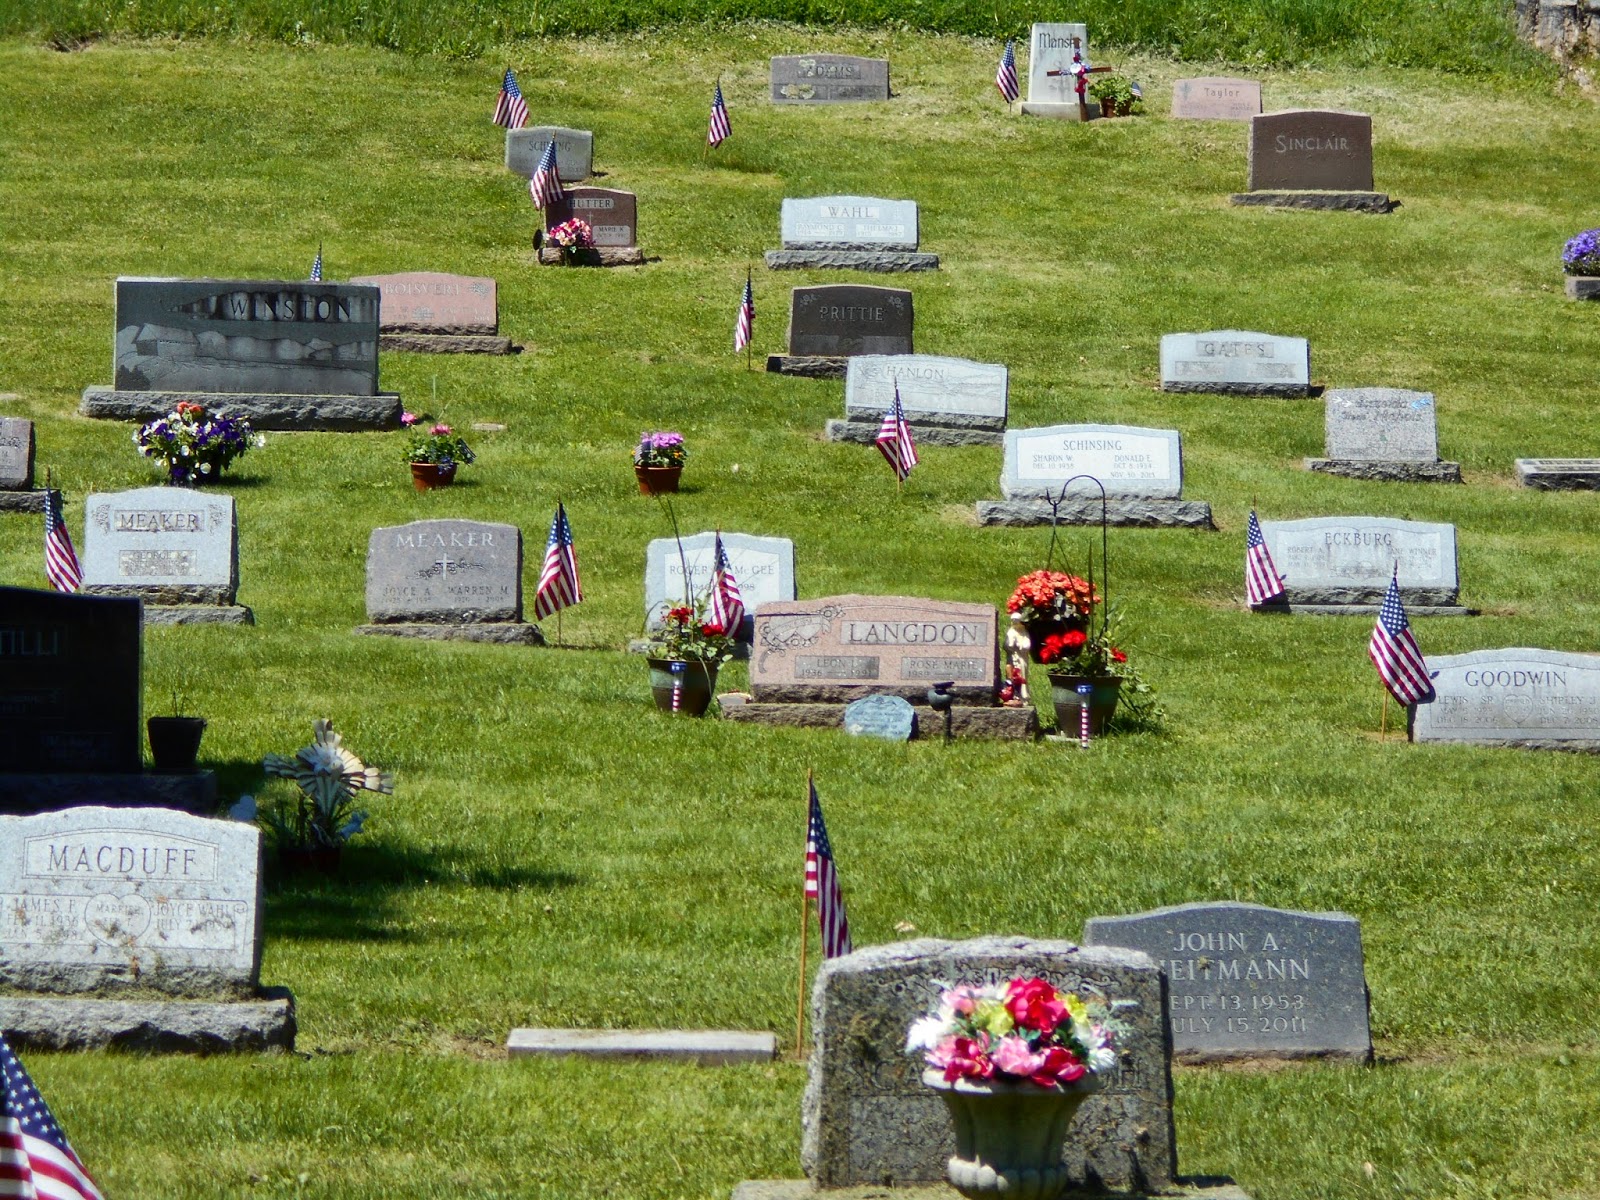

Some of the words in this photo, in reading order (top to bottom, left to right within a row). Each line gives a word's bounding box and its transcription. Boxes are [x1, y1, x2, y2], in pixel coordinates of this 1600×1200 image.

[1203, 87, 1240, 98] Taylor
[569, 200, 611, 208] HUTTER
[828, 206, 874, 218] WAHL
[385, 283, 461, 295] BOISVERT
[230, 299, 350, 319] WINSTON
[820, 306, 884, 321] PRITTIE
[1204, 343, 1265, 356] GATES
[887, 366, 944, 379] HANLON
[1063, 440, 1122, 451] SCHINSING
[1114, 454, 1144, 462] DONALD
[120, 513, 198, 529] MEAKER
[395, 532, 496, 547] MEAKER
[1325, 532, 1393, 546] ECKBURG
[383, 586, 416, 597] JOYCE
[447, 587, 492, 596] WARREN
[850, 623, 978, 644] LANGDON
[817, 658, 846, 668] LEON
[910, 660, 937, 669] ROSE
[944, 660, 978, 670] MARIE
[1465, 670, 1567, 687] GOODWIN
[1438, 695, 1469, 705] LEWIS
[1540, 696, 1584, 705] SHIRLEY
[48, 845, 196, 874] MACDUFF
[11, 898, 60, 913] JAMES
[153, 902, 193, 917] JOYCE
[1173, 932, 1244, 951] JOHN
[1262, 932, 1286, 951] A.
[1171, 995, 1211, 1010] EPT.
[1252, 995, 1304, 1010] 1953
[1173, 1017, 1215, 1033] ULY
[1259, 1017, 1307, 1033] 2011
